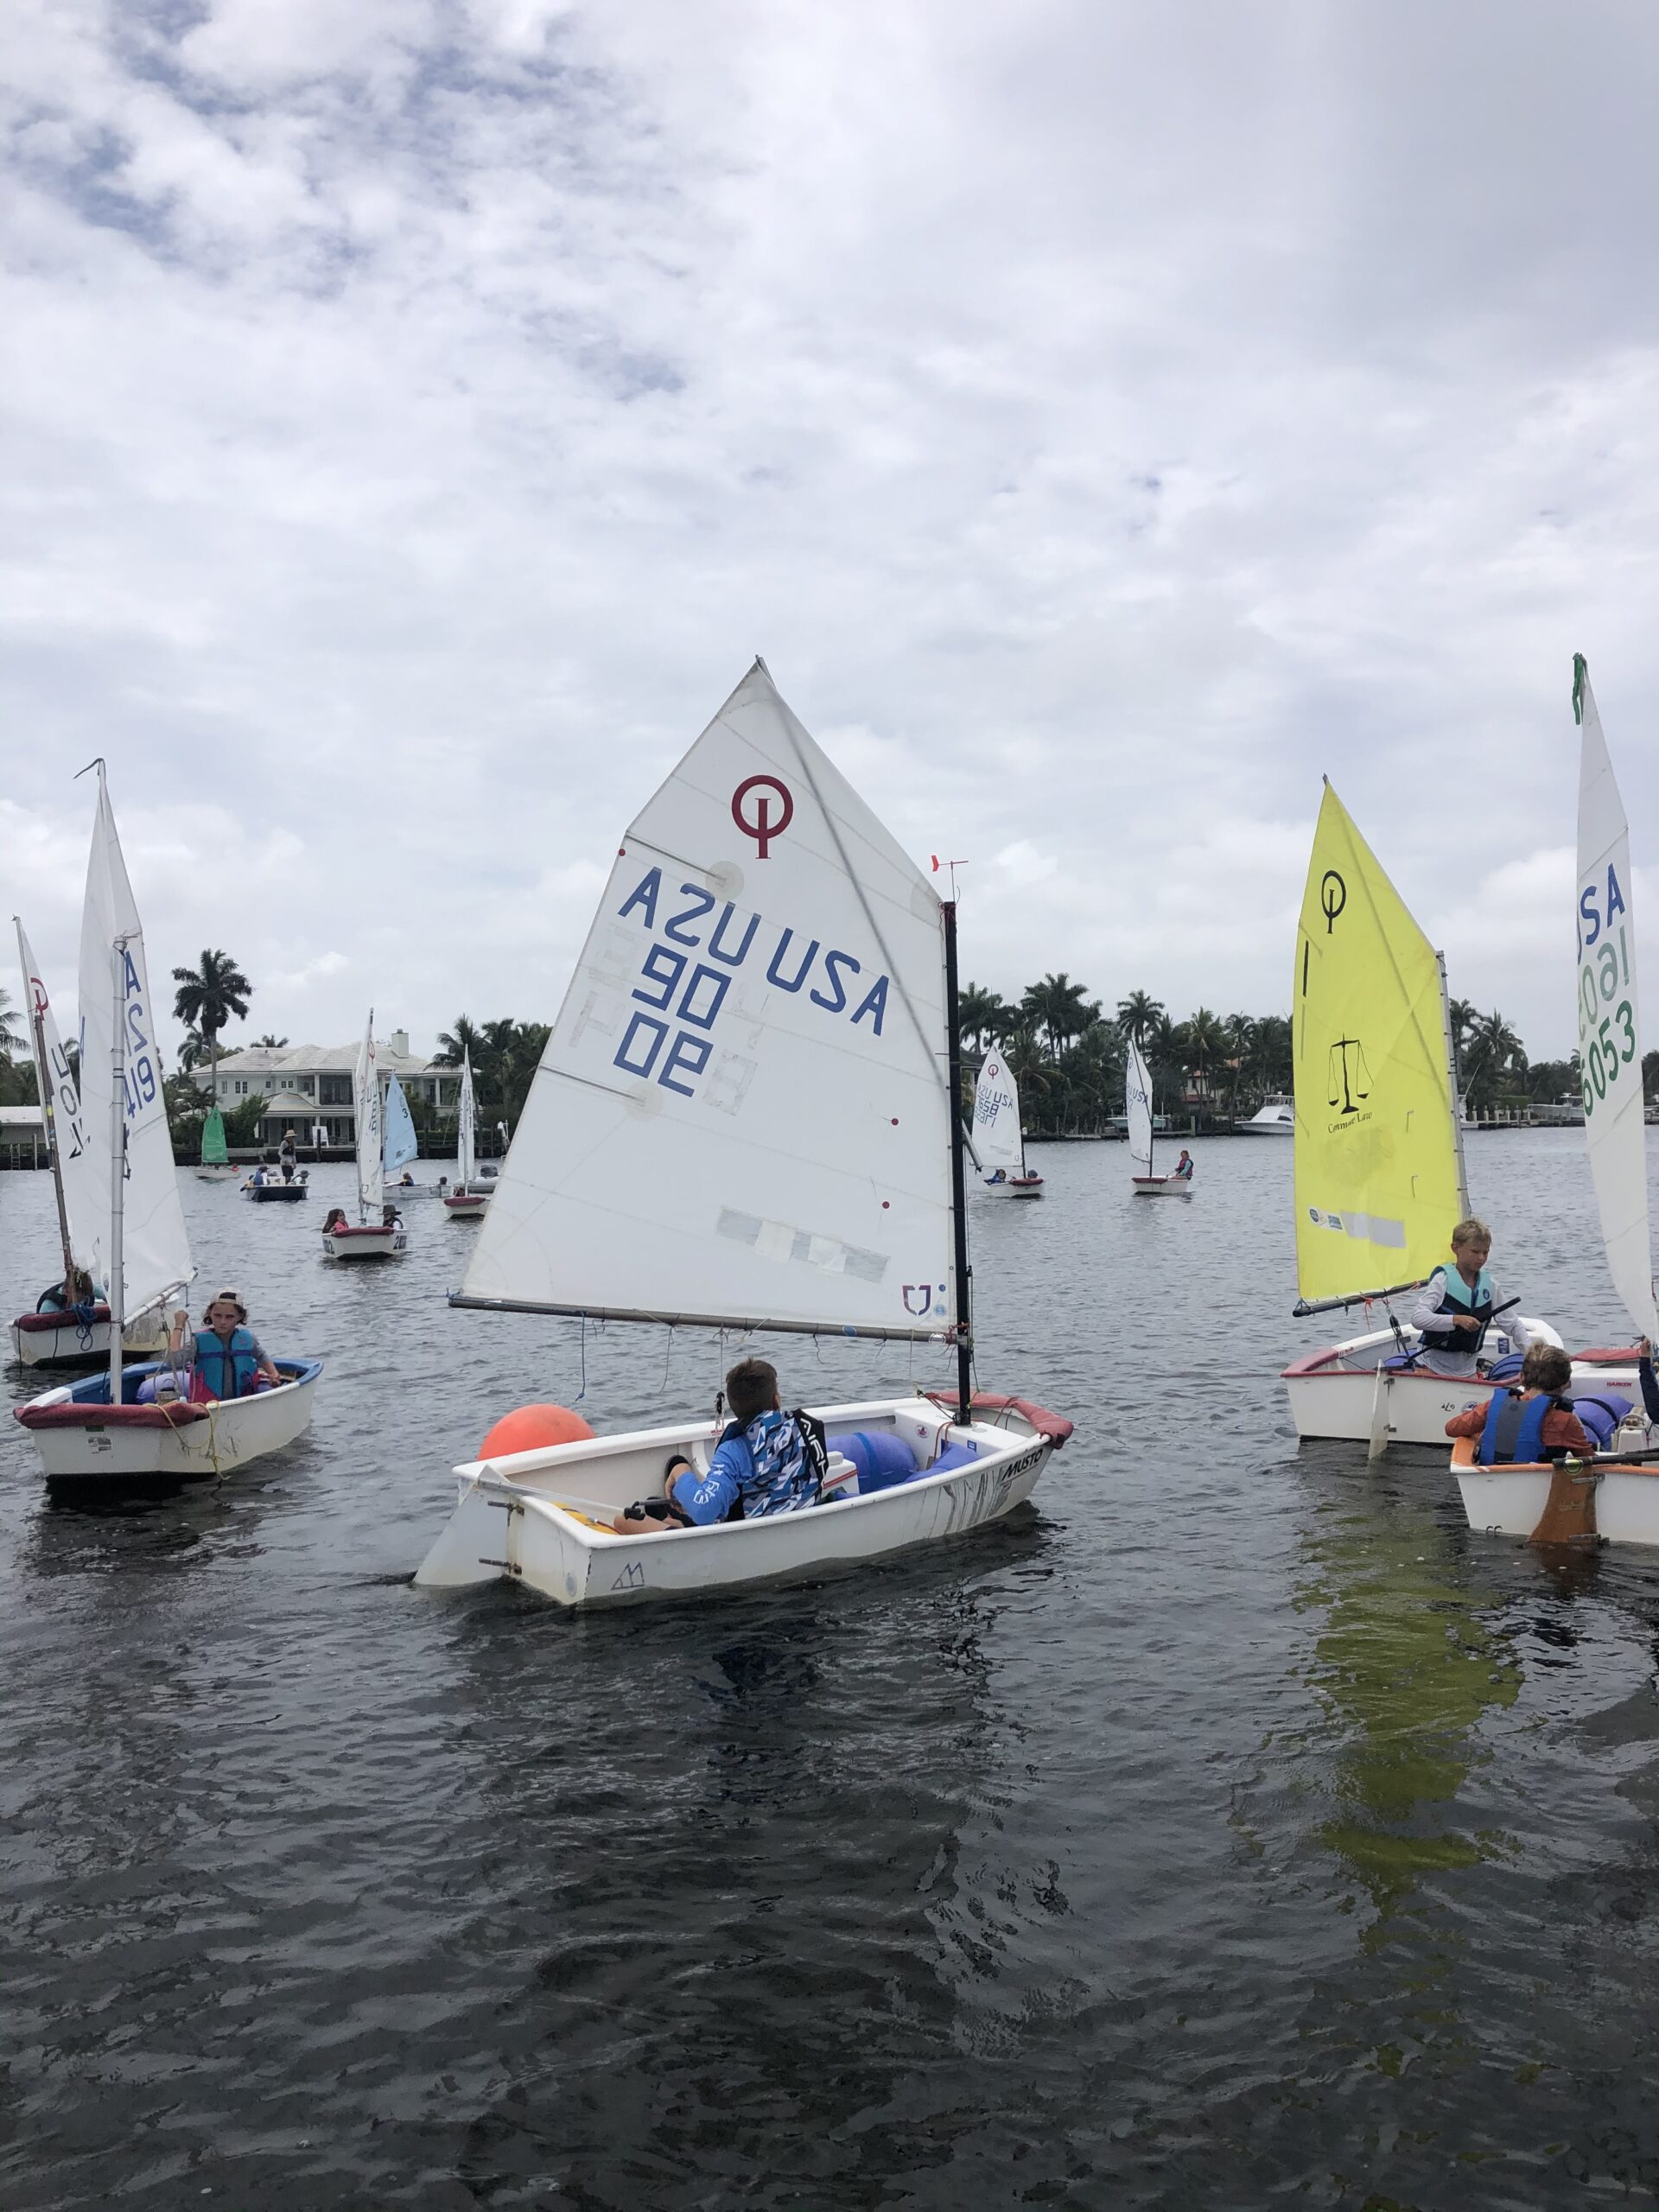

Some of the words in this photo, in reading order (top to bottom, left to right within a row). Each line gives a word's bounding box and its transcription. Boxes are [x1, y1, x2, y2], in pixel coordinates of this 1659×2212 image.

[631, 943, 732, 1030] 90
[766, 927, 890, 1037] USA
[994, 1091, 1014, 1109] USA
[1002, 1449, 1044, 1481] MUSTO
